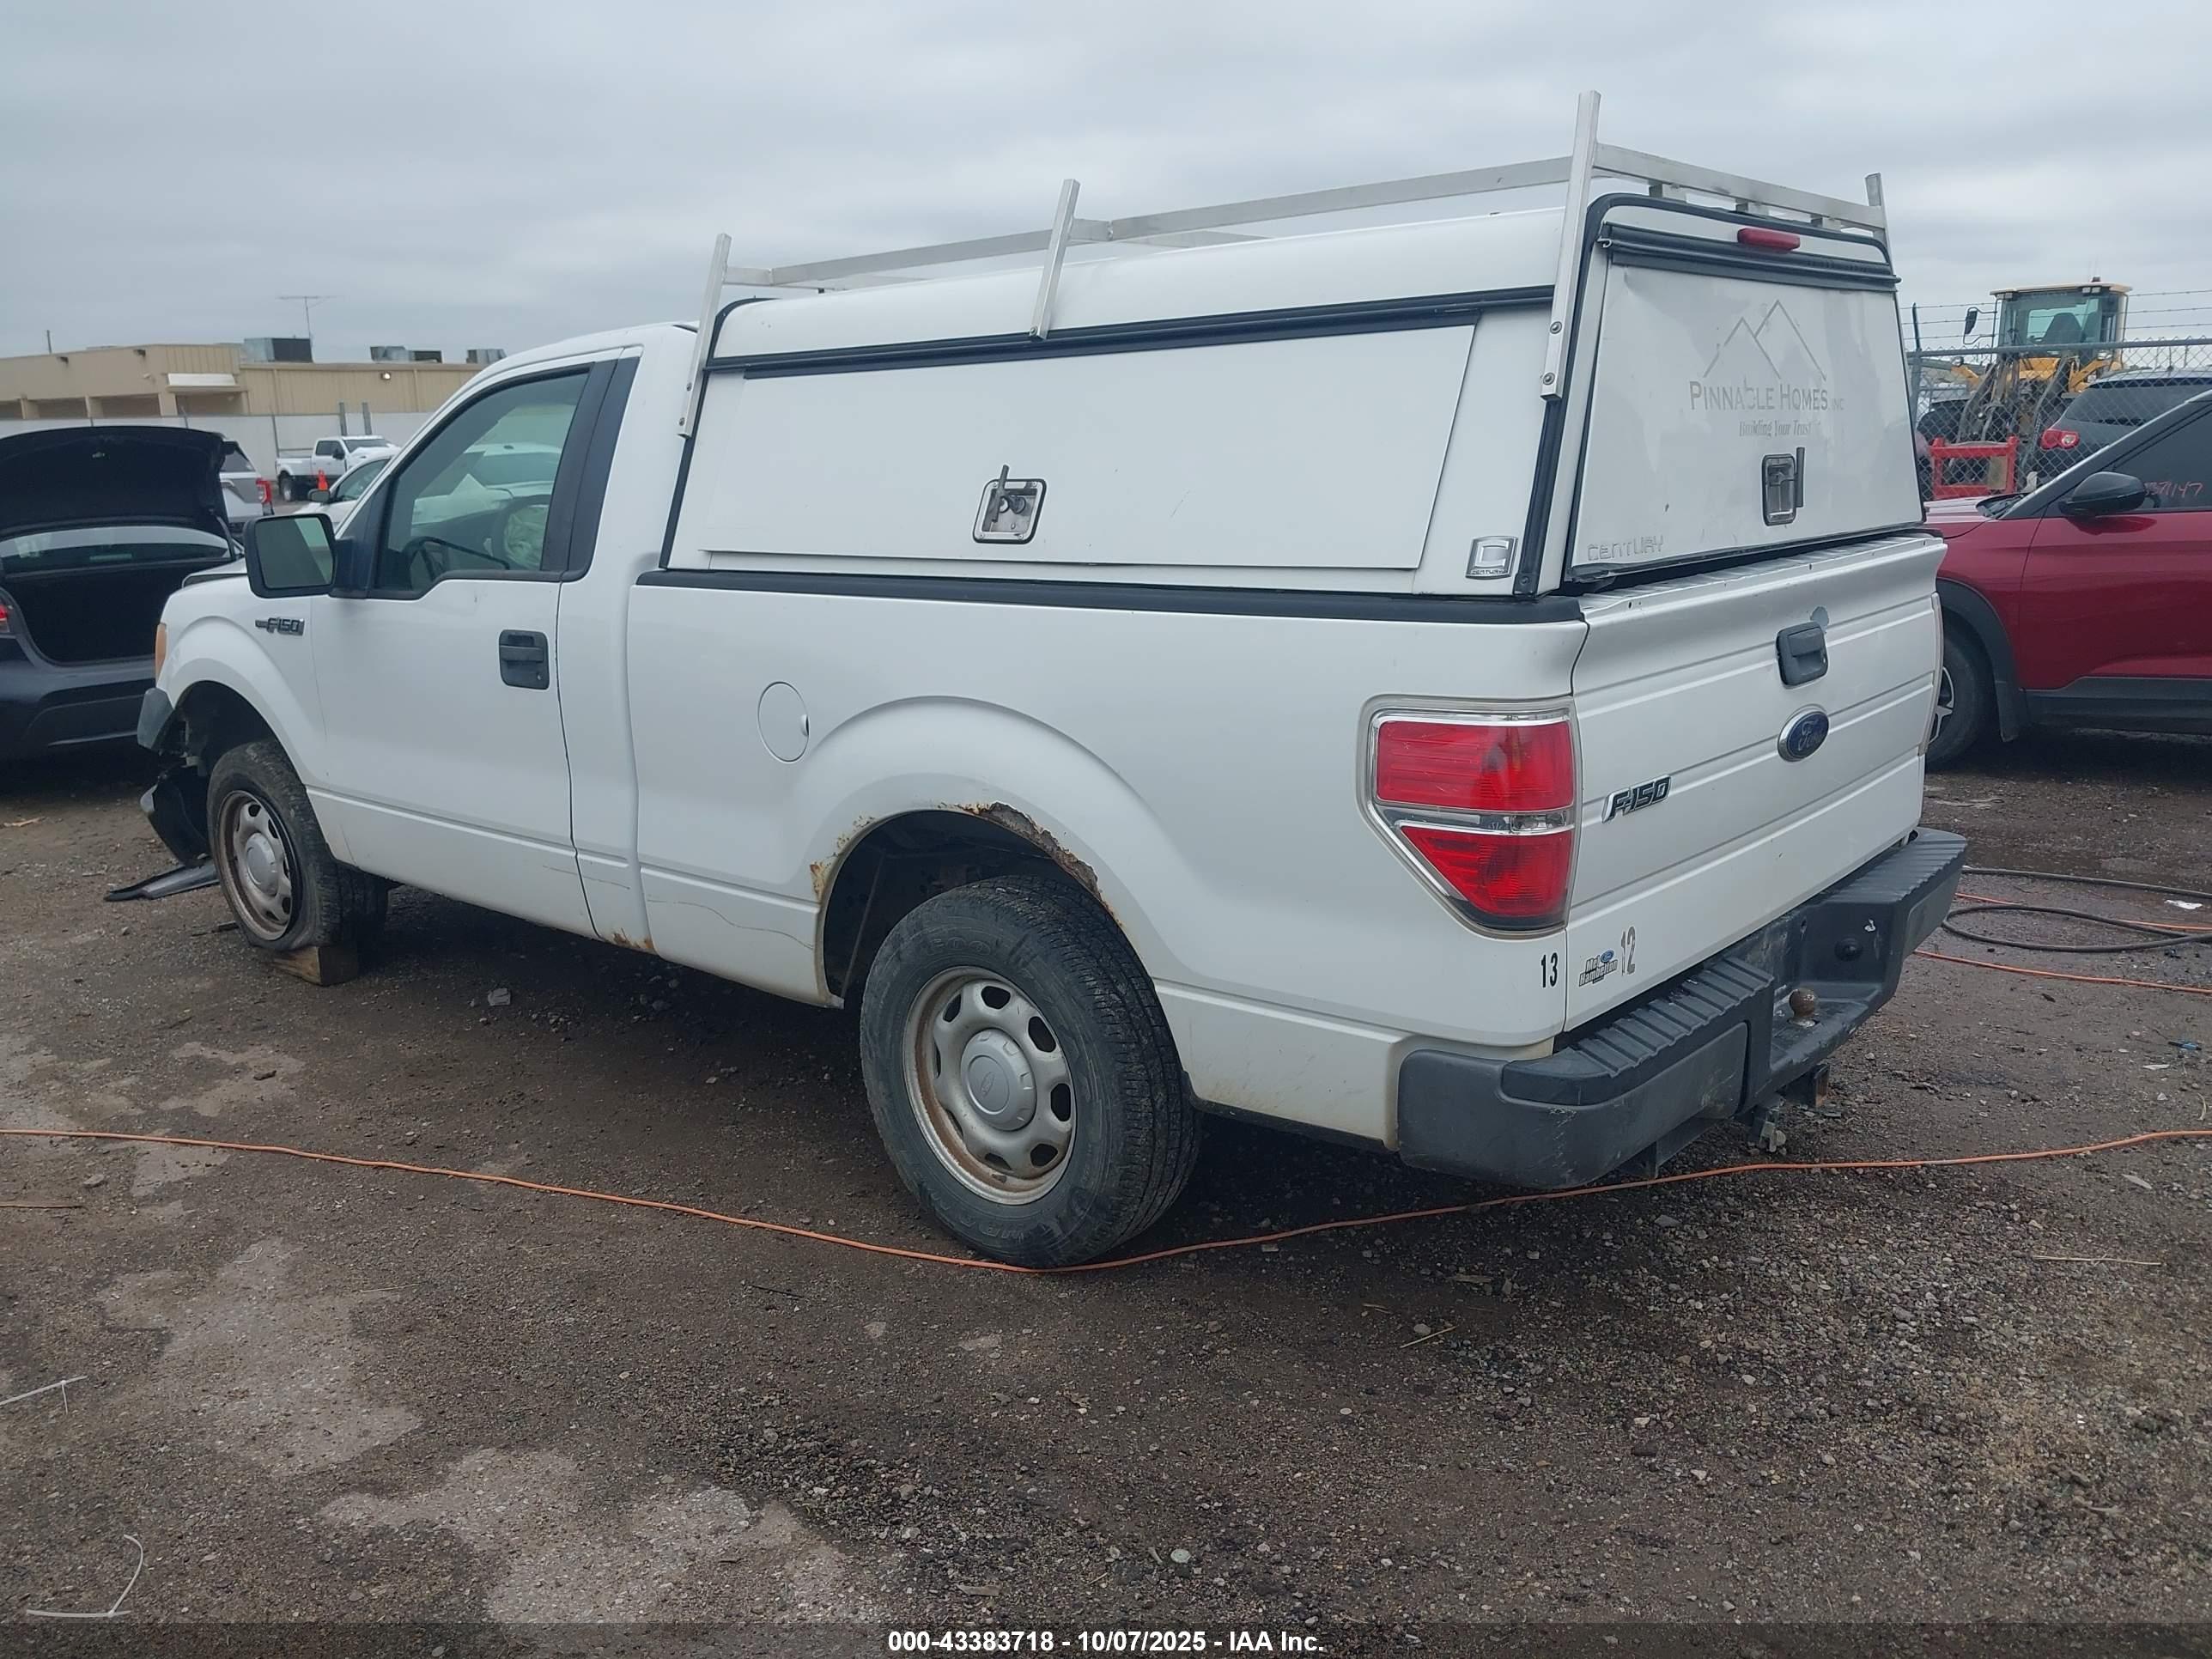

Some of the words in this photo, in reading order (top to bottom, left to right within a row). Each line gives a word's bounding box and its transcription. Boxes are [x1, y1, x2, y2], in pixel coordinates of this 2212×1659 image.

[1774, 419, 1791, 437] Your
[1540, 951, 1559, 988] 13
[1620, 926, 1636, 976] 12
